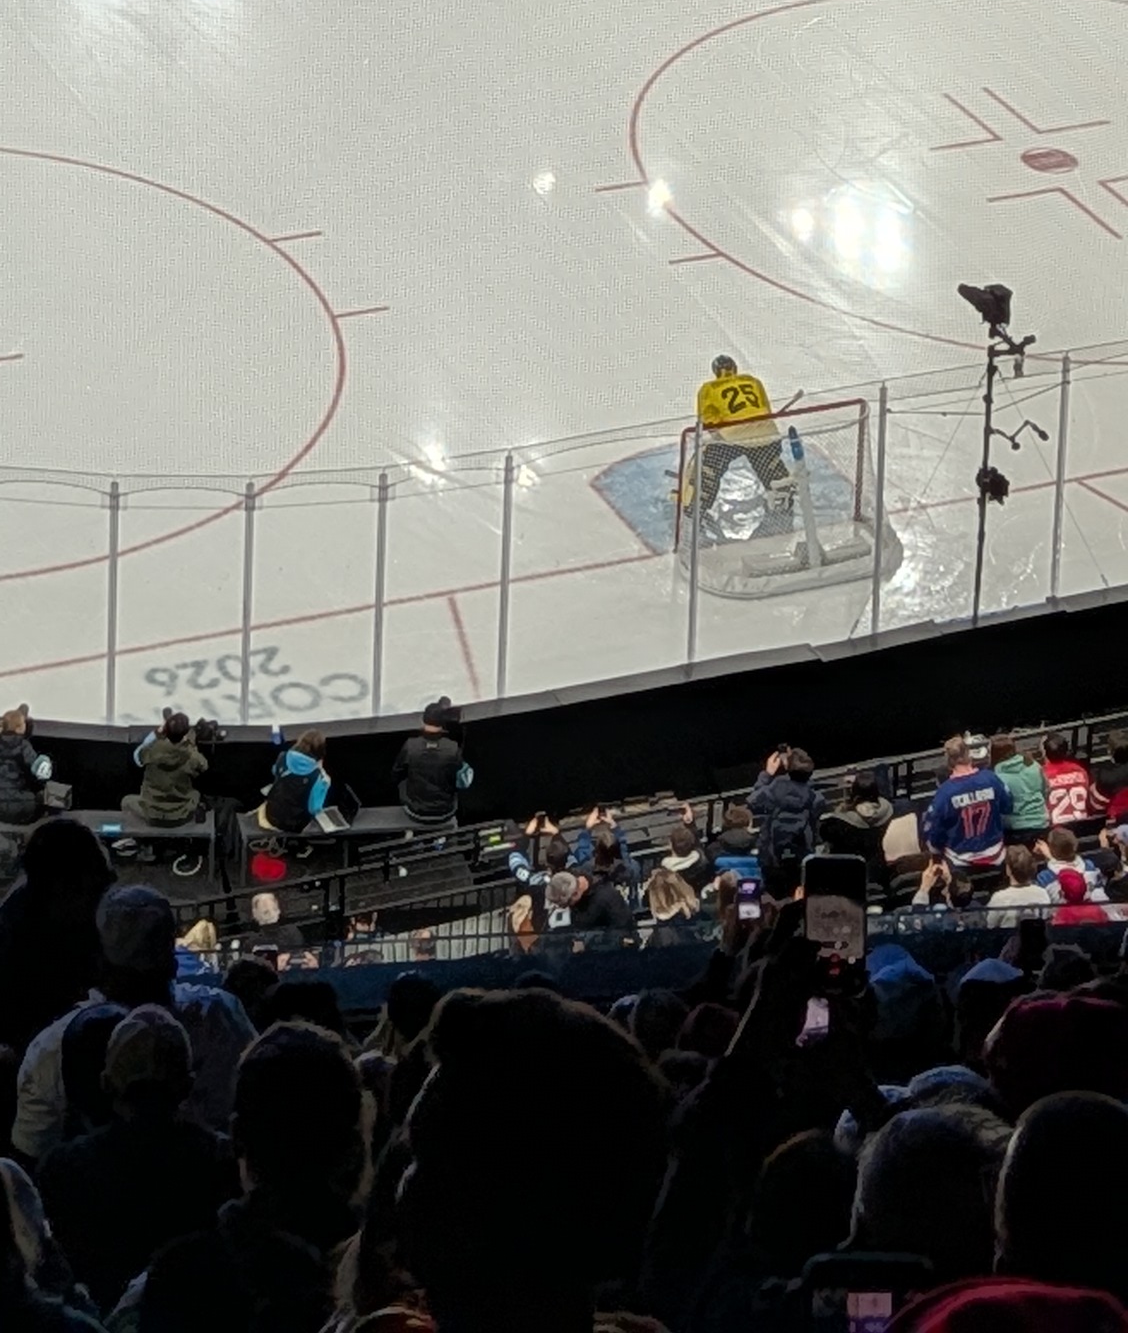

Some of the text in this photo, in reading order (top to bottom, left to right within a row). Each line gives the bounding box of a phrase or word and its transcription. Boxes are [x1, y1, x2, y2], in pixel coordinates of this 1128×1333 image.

[721, 384, 760, 414] 25
[144, 646, 292, 697] 2026
[961, 801, 991, 839] 17
[1049, 787, 1088, 825] 29
